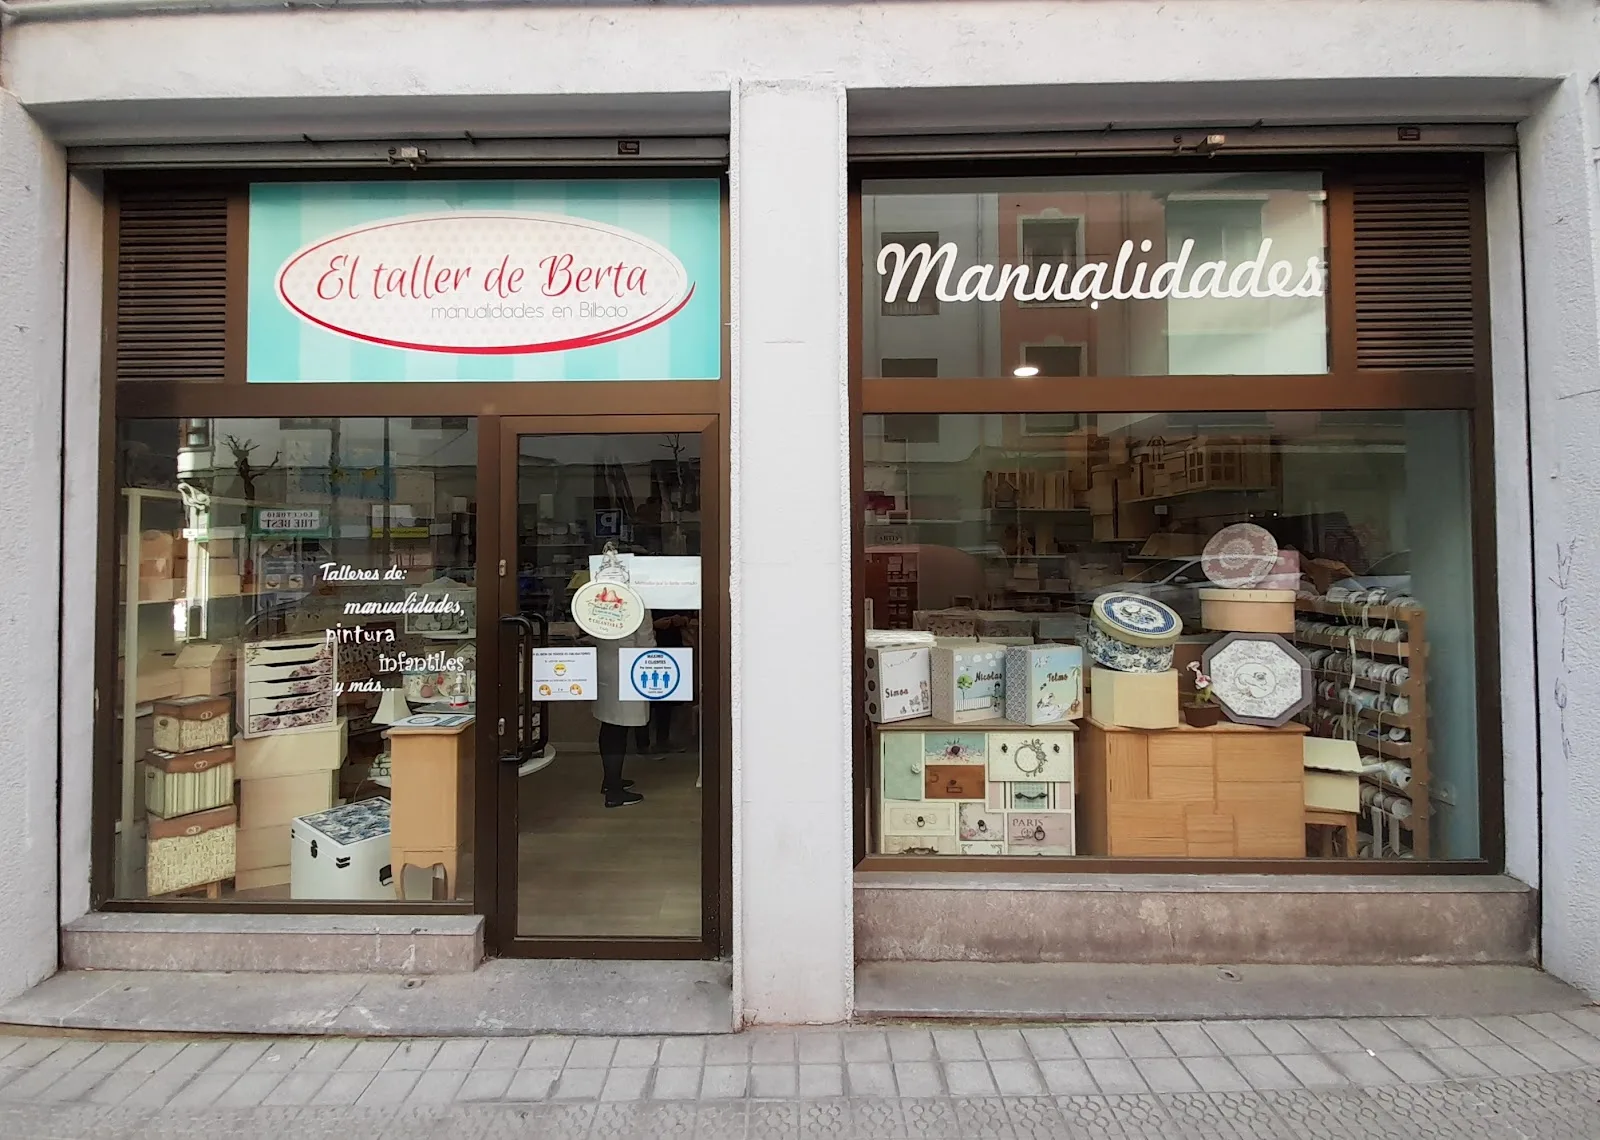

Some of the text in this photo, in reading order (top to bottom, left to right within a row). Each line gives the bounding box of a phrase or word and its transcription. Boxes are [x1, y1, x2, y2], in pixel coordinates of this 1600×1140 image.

[317, 253, 648, 300] El taller de Berta
[876, 238, 1327, 304] Manualidades
[431, 301, 628, 319] manualidades en Bilbao
[319, 562, 408, 581] Talleres de:
[343, 592, 465, 616] manualidades,
[325, 623, 395, 651] pintura
[378, 650, 465, 672] infantiles
[332, 677, 395, 697] y más...
[1012, 818, 1045, 827] PARIS
